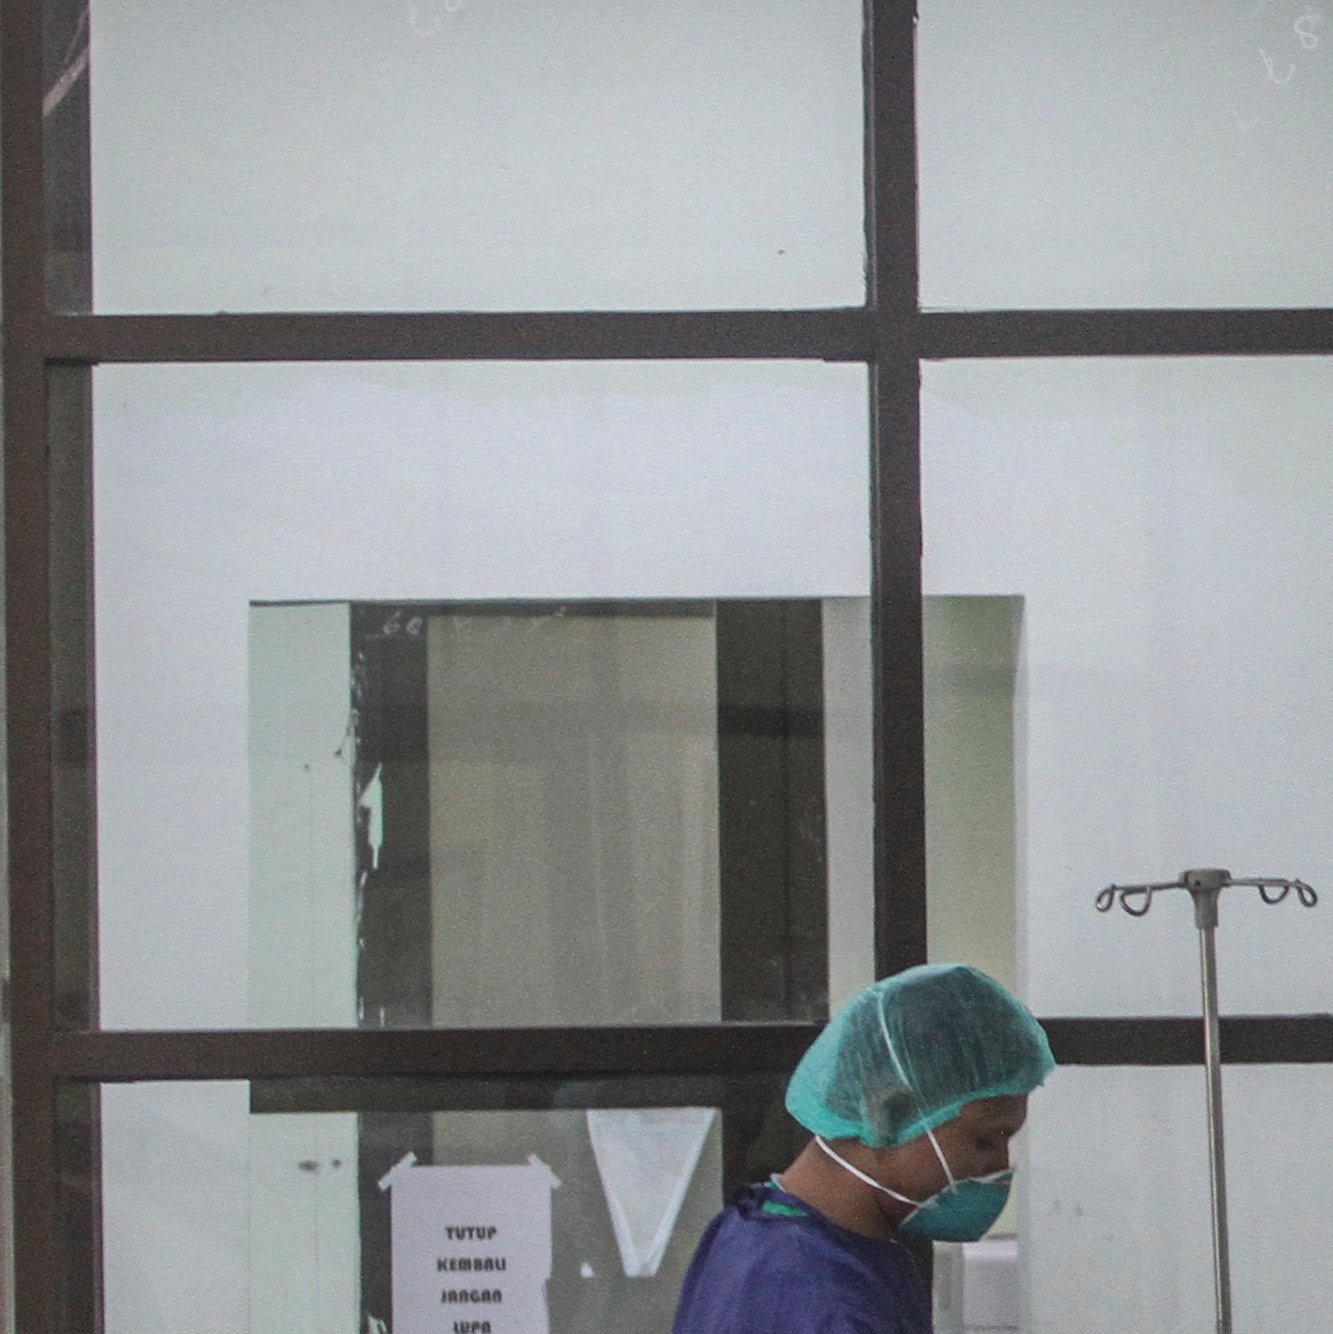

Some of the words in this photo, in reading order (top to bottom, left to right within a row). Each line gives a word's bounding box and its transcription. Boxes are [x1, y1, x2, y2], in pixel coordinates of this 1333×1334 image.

[445, 1226, 497, 1240] TUTUP
[437, 1257, 506, 1272] KEMBALI
[441, 1289, 502, 1304] JANGAN
[453, 1320, 492, 1334] LUPA
